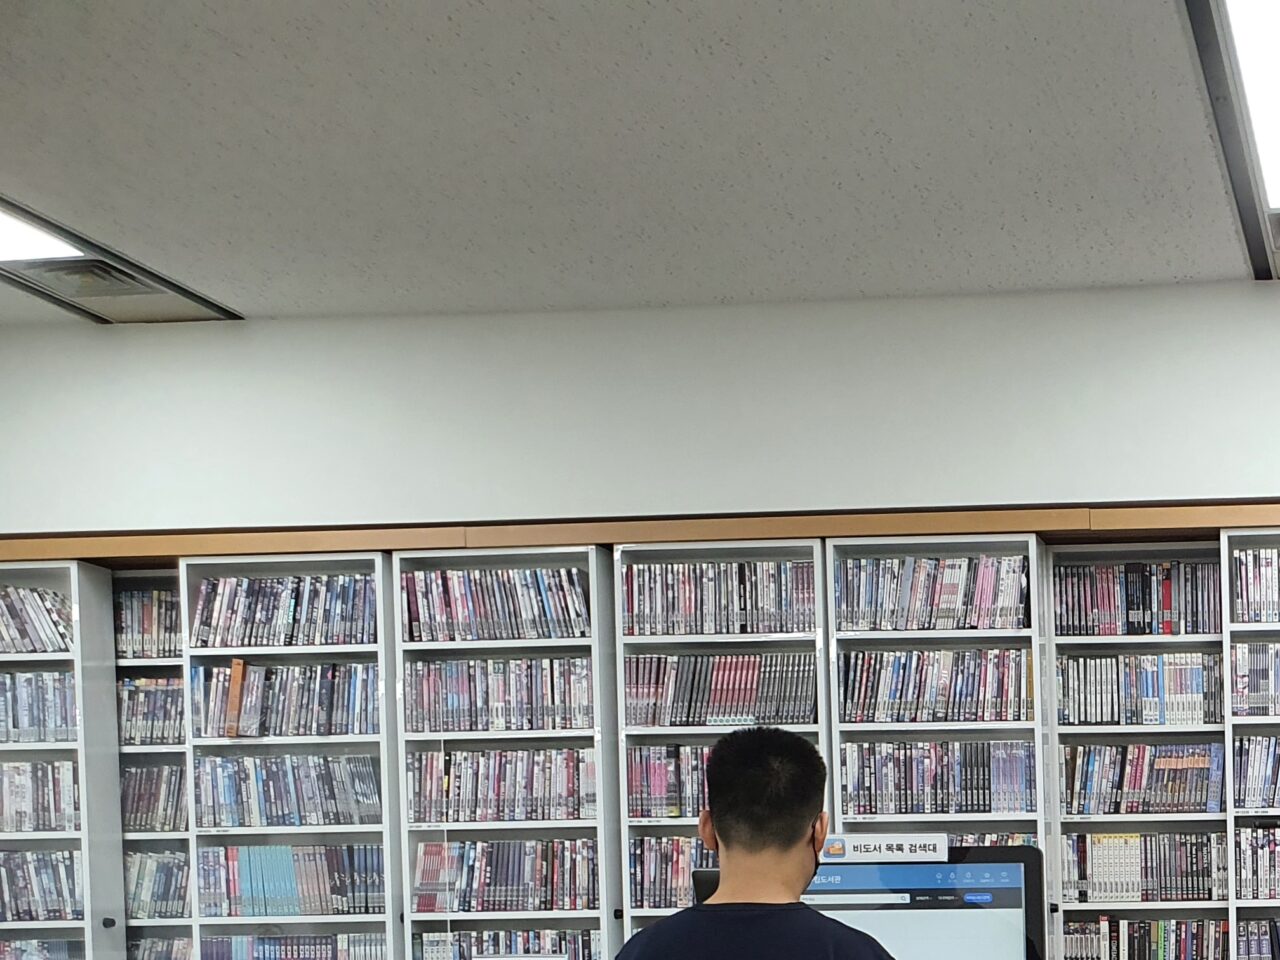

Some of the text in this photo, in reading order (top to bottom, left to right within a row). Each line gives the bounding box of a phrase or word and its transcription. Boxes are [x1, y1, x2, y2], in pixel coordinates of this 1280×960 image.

[853, 843, 938, 853] 비도서 목록 검색대
